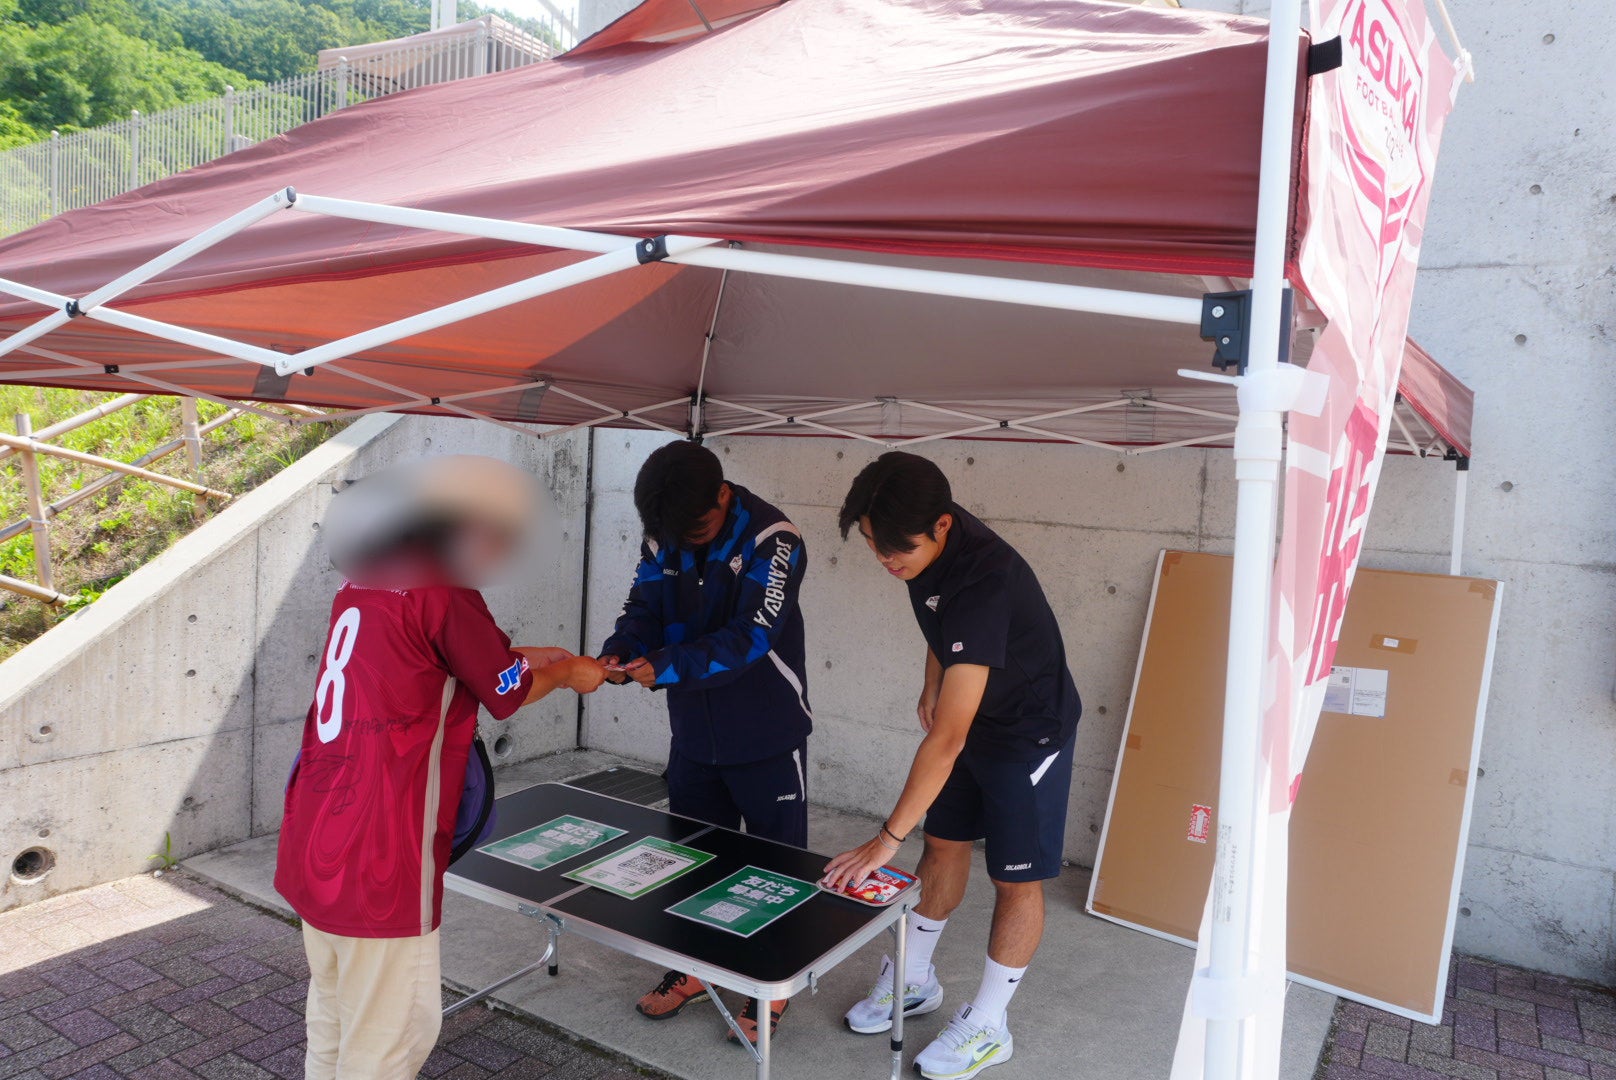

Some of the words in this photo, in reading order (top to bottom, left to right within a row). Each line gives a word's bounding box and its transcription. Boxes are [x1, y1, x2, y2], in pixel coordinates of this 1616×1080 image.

[316, 606, 361, 744] 8
[727, 884, 786, 905] 募集中
[741, 875, 801, 897] 友だち
